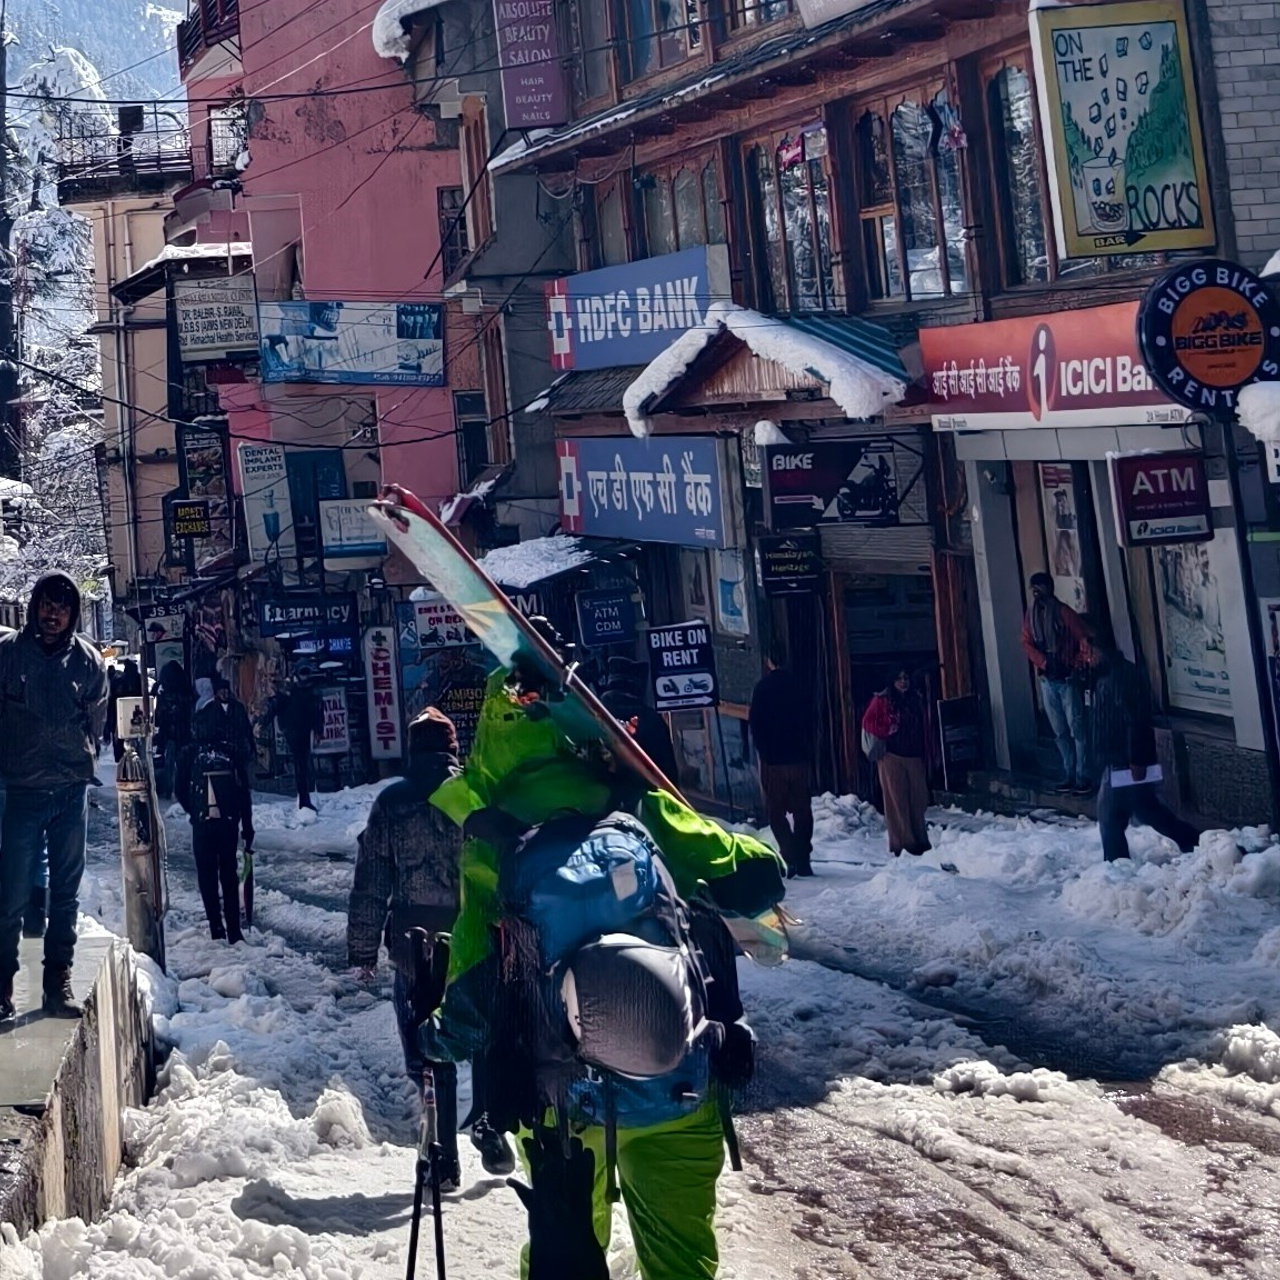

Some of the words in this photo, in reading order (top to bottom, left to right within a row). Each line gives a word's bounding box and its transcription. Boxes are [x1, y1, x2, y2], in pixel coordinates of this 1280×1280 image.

[498, 0, 553, 19] ABSOLUTE
[505, 23, 550, 43] BEAUTY
[1055, 31, 1083, 57] ON
[509, 48, 552, 66] SALON
[1058, 57, 1094, 82] THE
[520, 77, 545, 86] HAIR
[515, 93, 553, 104] BEAUTY
[1125, 181, 1203, 230] ROCKS
[1095, 236, 1126, 248] BAR
[1158, 268, 1207, 314] BIGG
[1216, 267, 1268, 308] BIKE
[576, 289, 632, 343] HDFC
[636, 276, 703, 334] BANK
[1060, 356, 1113, 397] ICICI
[245, 448, 280, 457] DENTAL
[245, 455, 282, 465] IMPLANT
[772, 453, 814, 470] BIKE
[245, 464, 283, 474] EXPERTS
[681, 450, 713, 517] बैंक
[1132, 466, 1196, 496] ATM
[594, 606, 619, 620] ATM
[595, 620, 621, 633] CDM
[650, 630, 684, 649] BIKE
[687, 628, 708, 646] ON
[662, 649, 700, 667] RENT
[371, 647, 397, 751] CHEMIST
